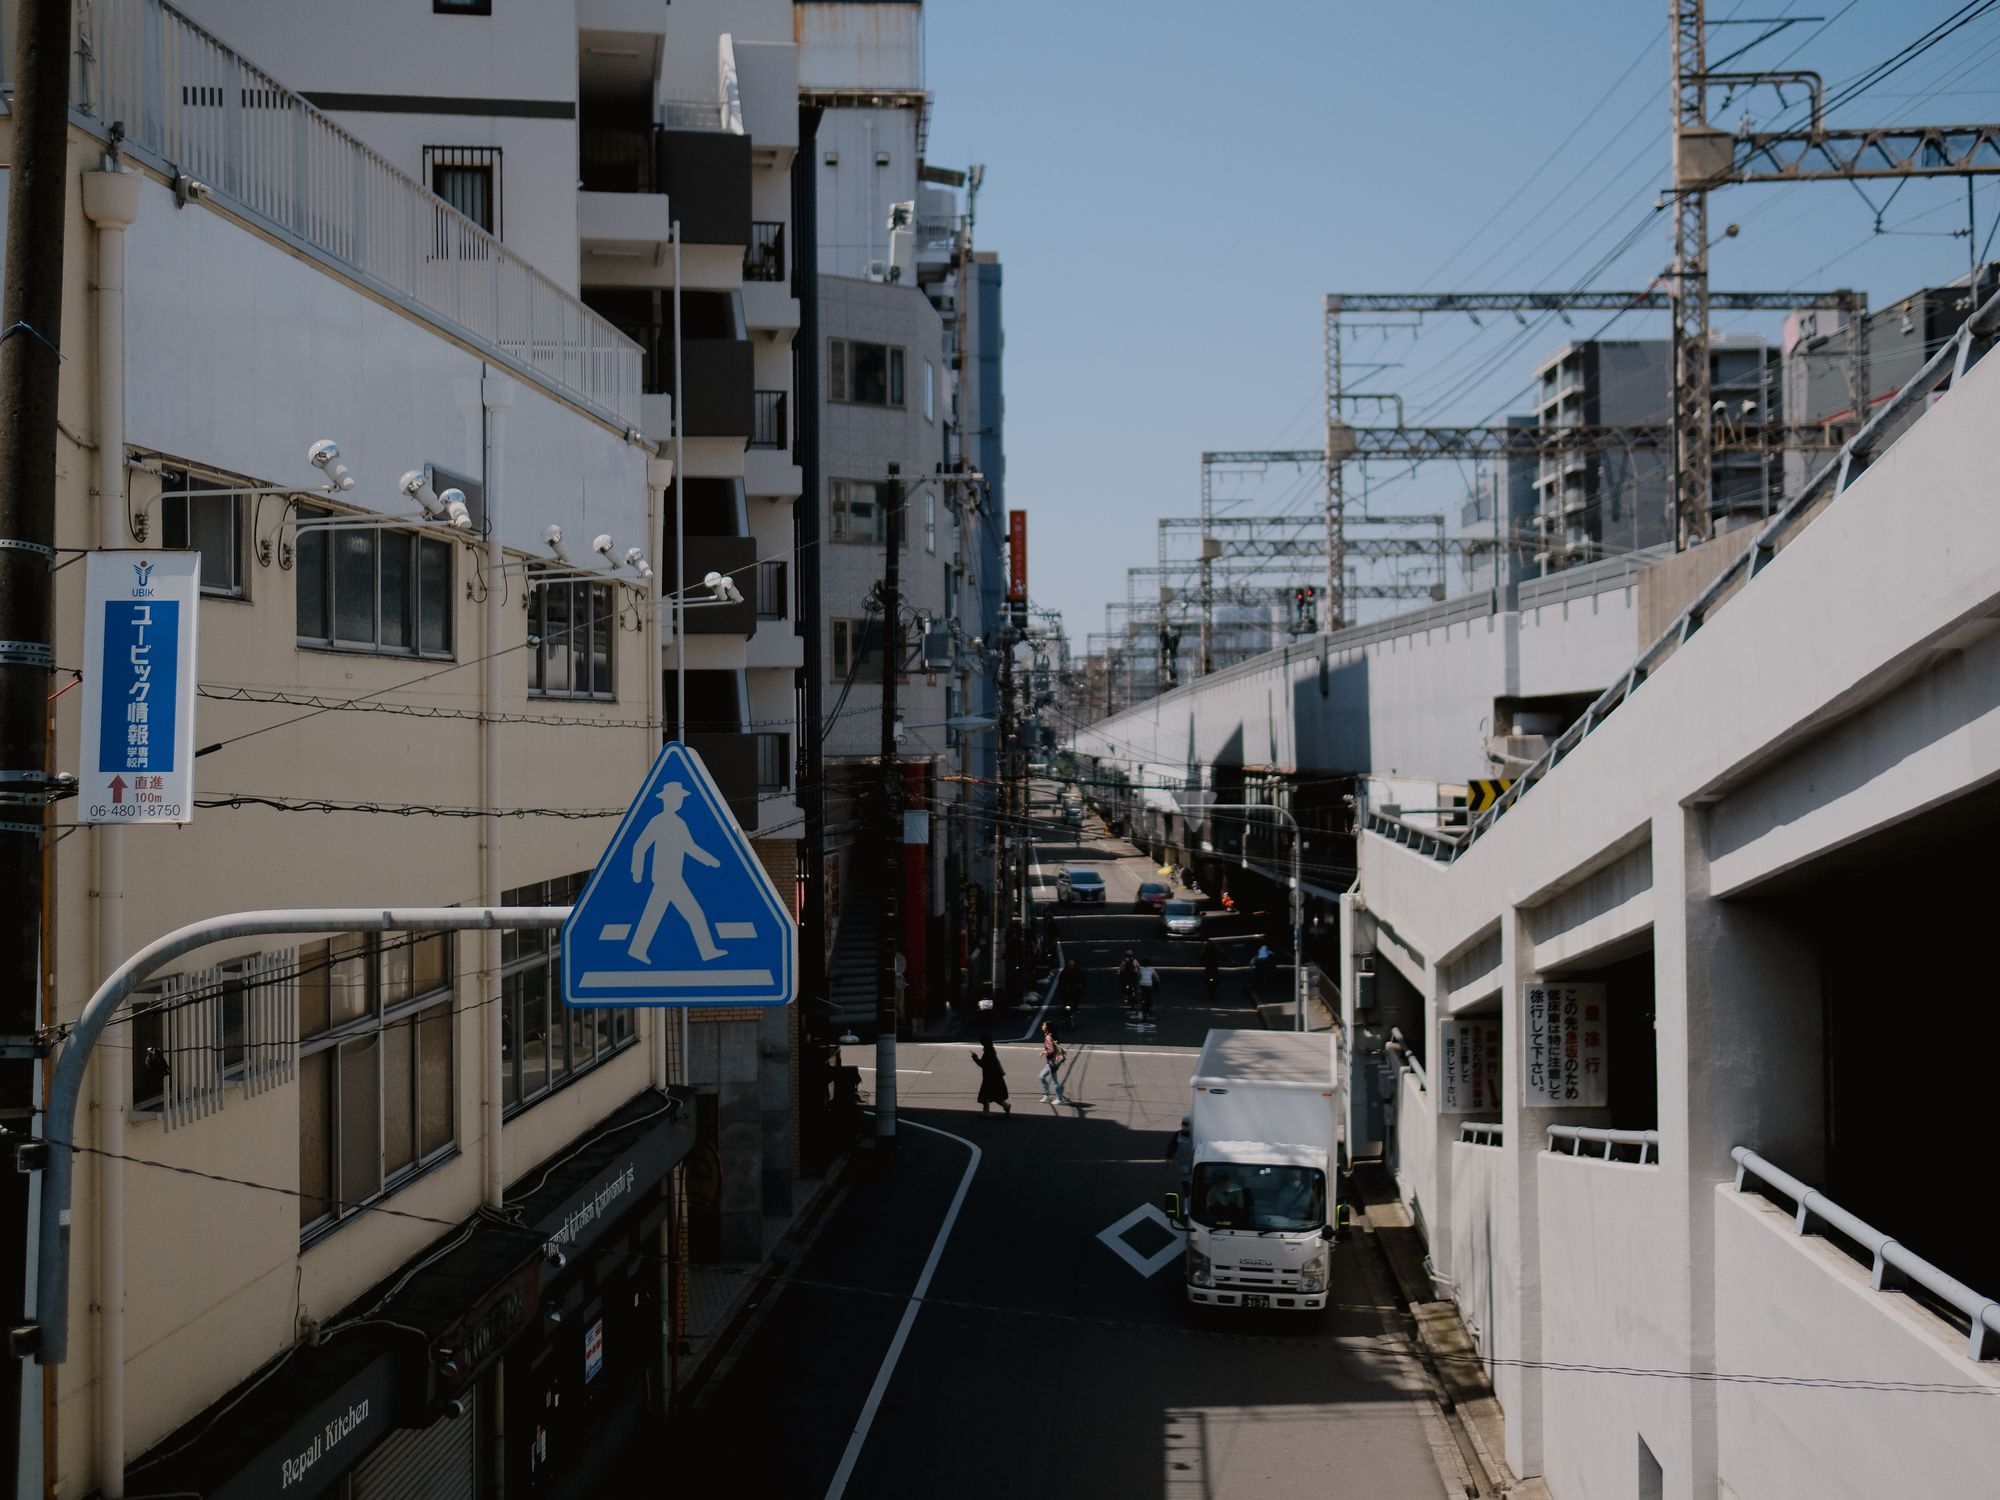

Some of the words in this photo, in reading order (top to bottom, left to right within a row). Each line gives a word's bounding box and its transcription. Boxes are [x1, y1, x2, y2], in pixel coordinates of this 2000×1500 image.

[132, 588, 154, 597] UBIK
[134, 775, 164, 790] 直進
[134, 792, 163, 803] 100m
[89, 804, 181, 818] 06-4801-8750
[1564, 989, 1579, 1100] この先急坂のため
[281, 1433, 322, 1489] Nepali
[325, 1398, 369, 1451] Kitchen
